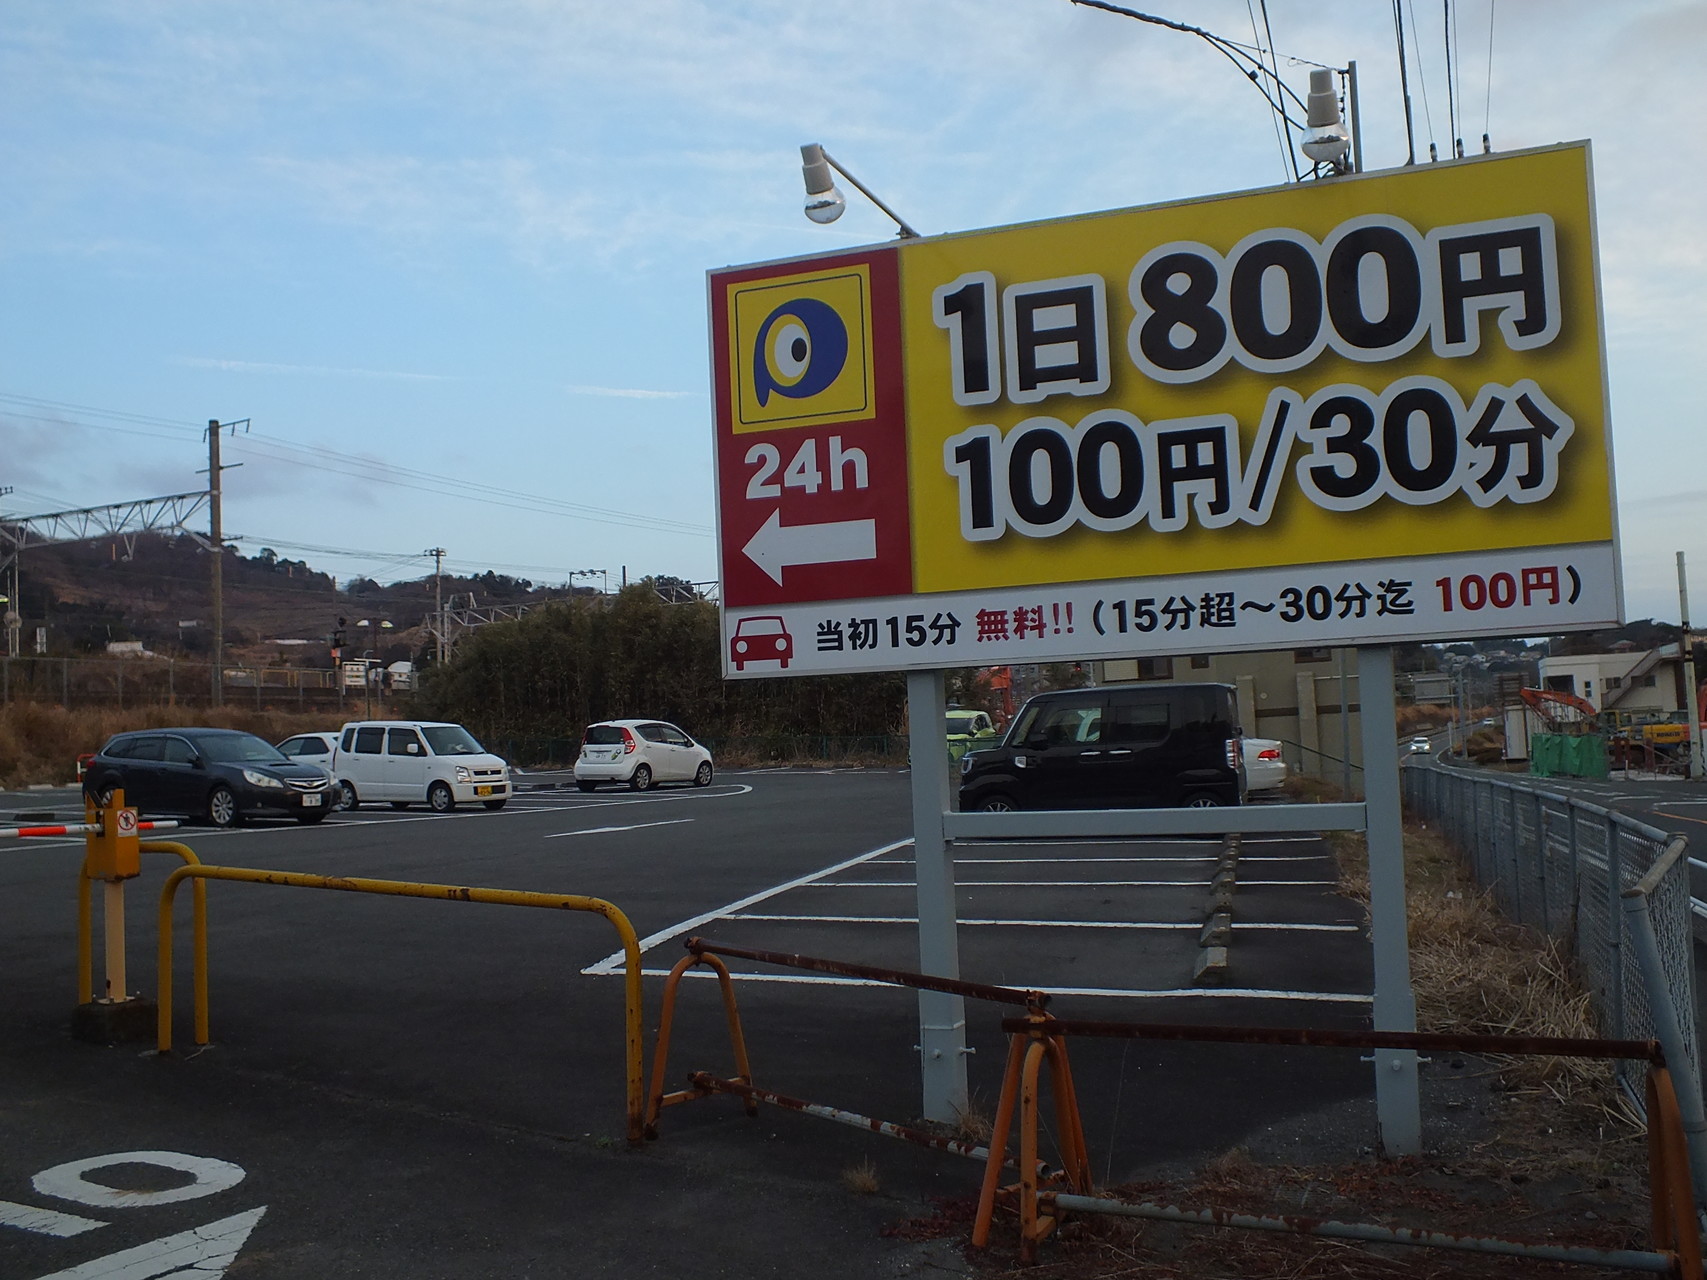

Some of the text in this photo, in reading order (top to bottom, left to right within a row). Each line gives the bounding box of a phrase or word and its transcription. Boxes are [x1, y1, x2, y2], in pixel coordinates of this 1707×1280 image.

[942, 224, 1549, 394] 1日 800円
[743, 434, 870, 500] 24h
[954, 387, 1562, 531] 100円/30分
[816, 611, 962, 652] 当初15分
[975, 601, 1075, 643] 無料!!
[1435, 564, 1582, 612] 100円)
